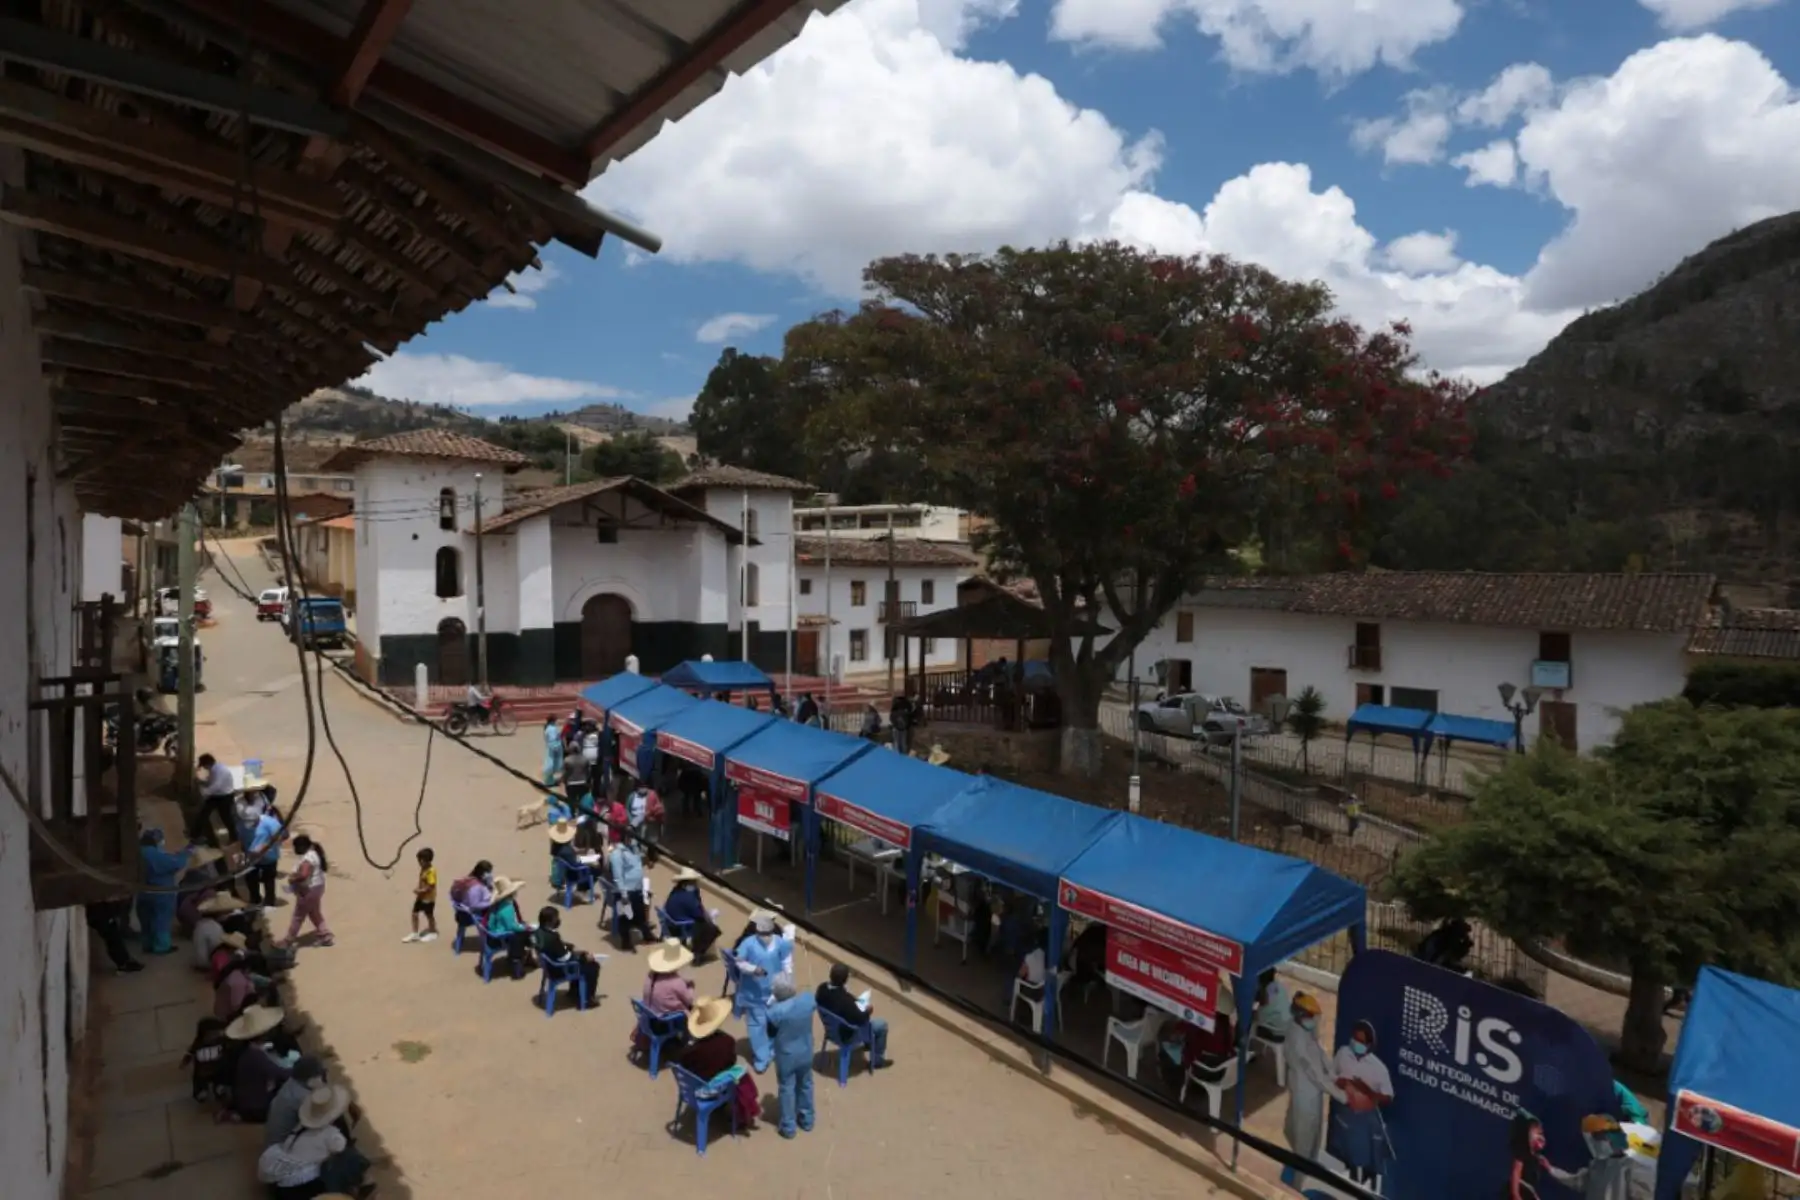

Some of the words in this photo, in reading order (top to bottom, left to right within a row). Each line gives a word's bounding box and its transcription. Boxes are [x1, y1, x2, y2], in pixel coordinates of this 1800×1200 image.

[1398, 1063, 1438, 1088] SALUD
[1400, 1048, 1423, 1067] RED
[1426, 1058, 1498, 1098] INTEGRADA
[1502, 1089, 1520, 1107] DE
